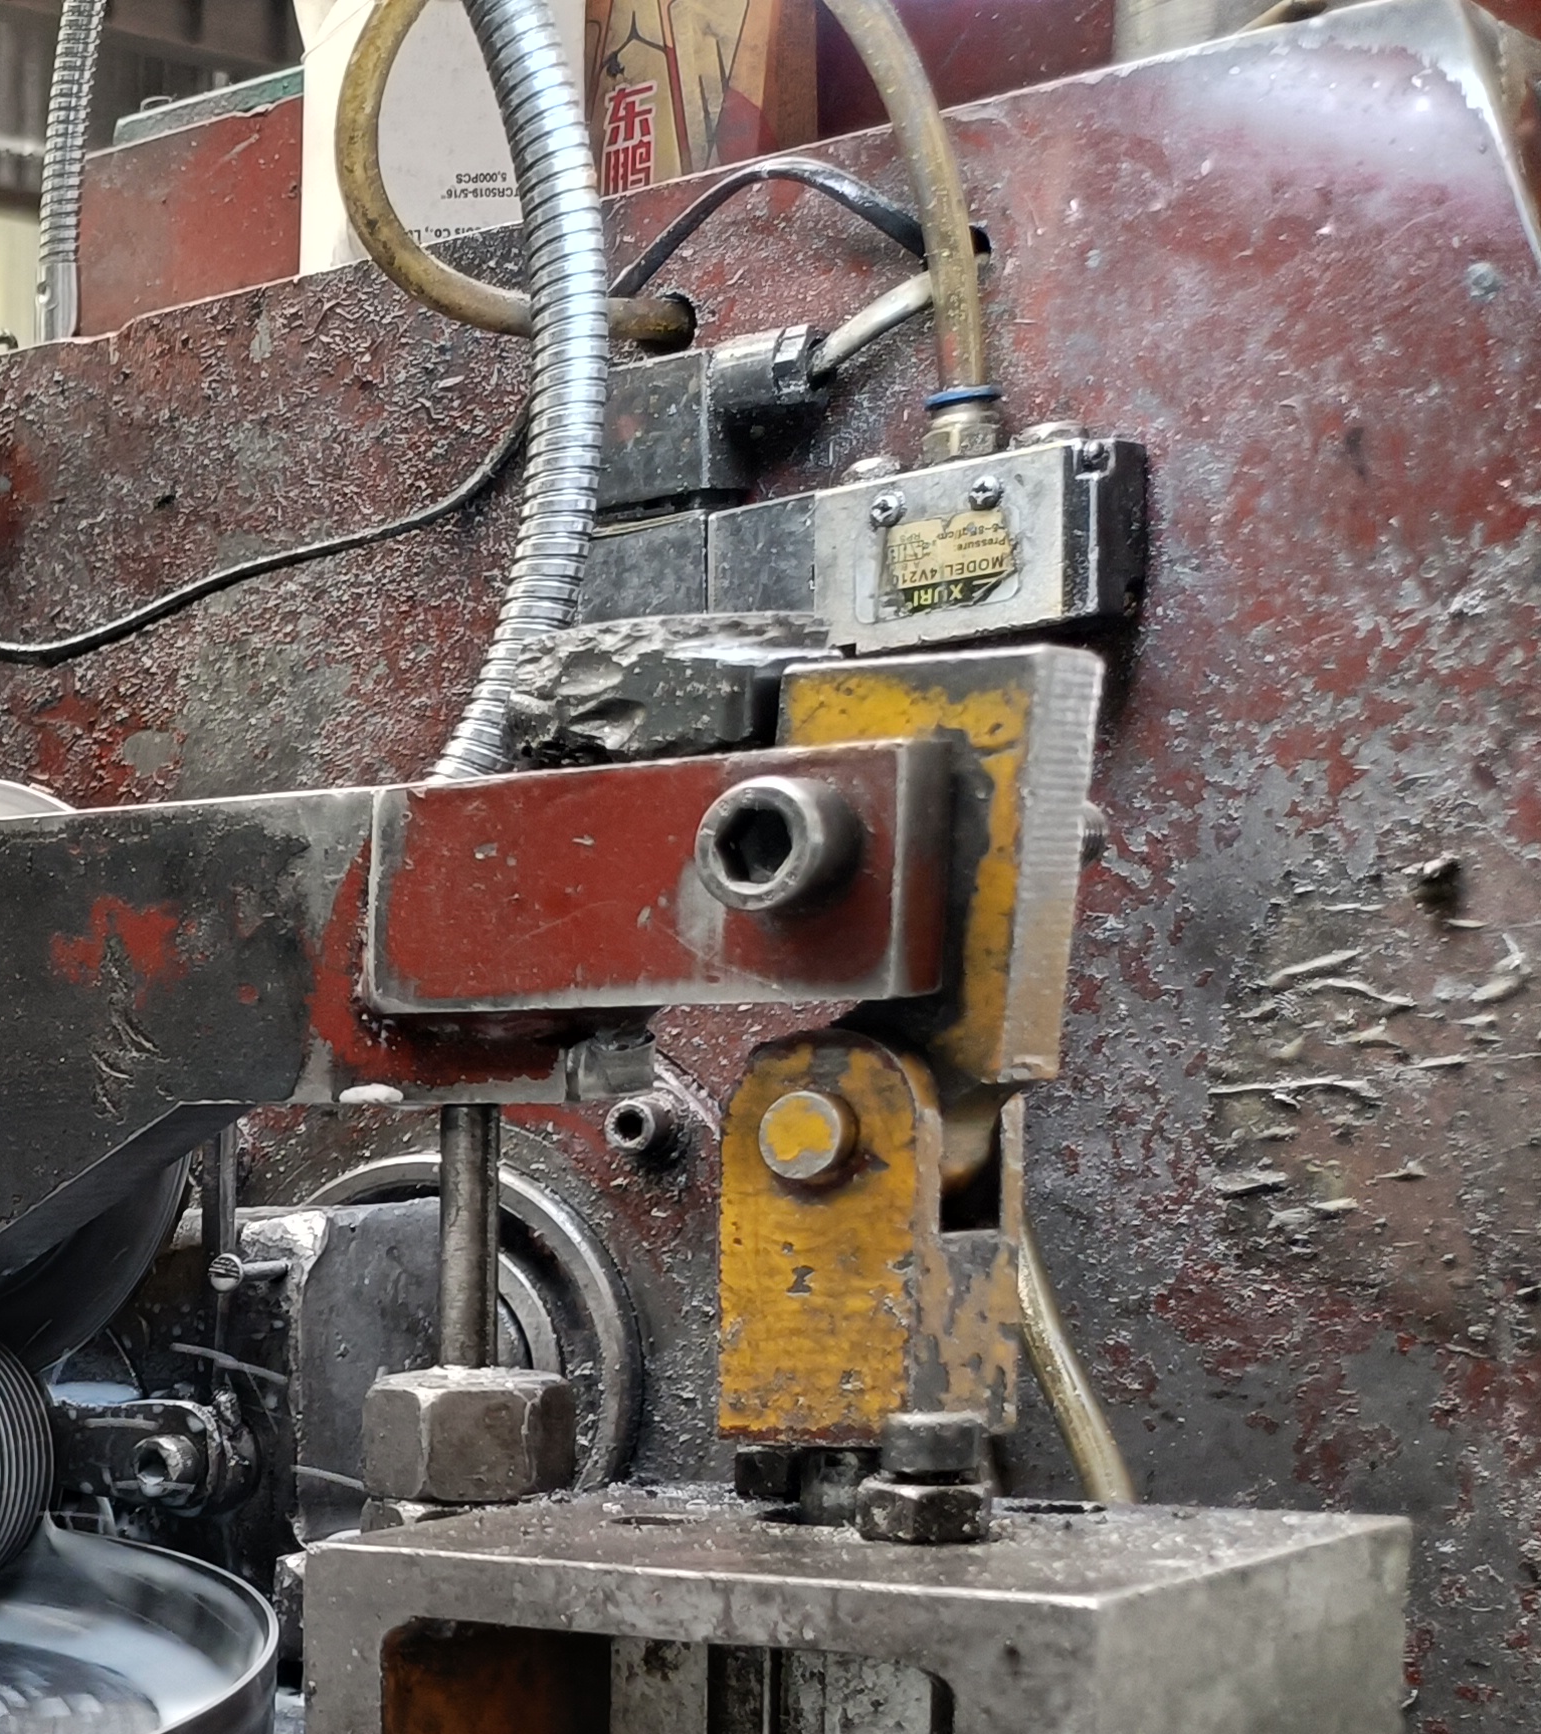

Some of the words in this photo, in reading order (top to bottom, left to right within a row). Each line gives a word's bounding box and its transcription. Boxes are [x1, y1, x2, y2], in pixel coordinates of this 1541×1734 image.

[602, 83, 655, 196] 东鹏
[455, 171, 508, 184] 5,000PCS
[944, 556, 1004, 576] MODEL
[912, 582, 964, 607] XURI
